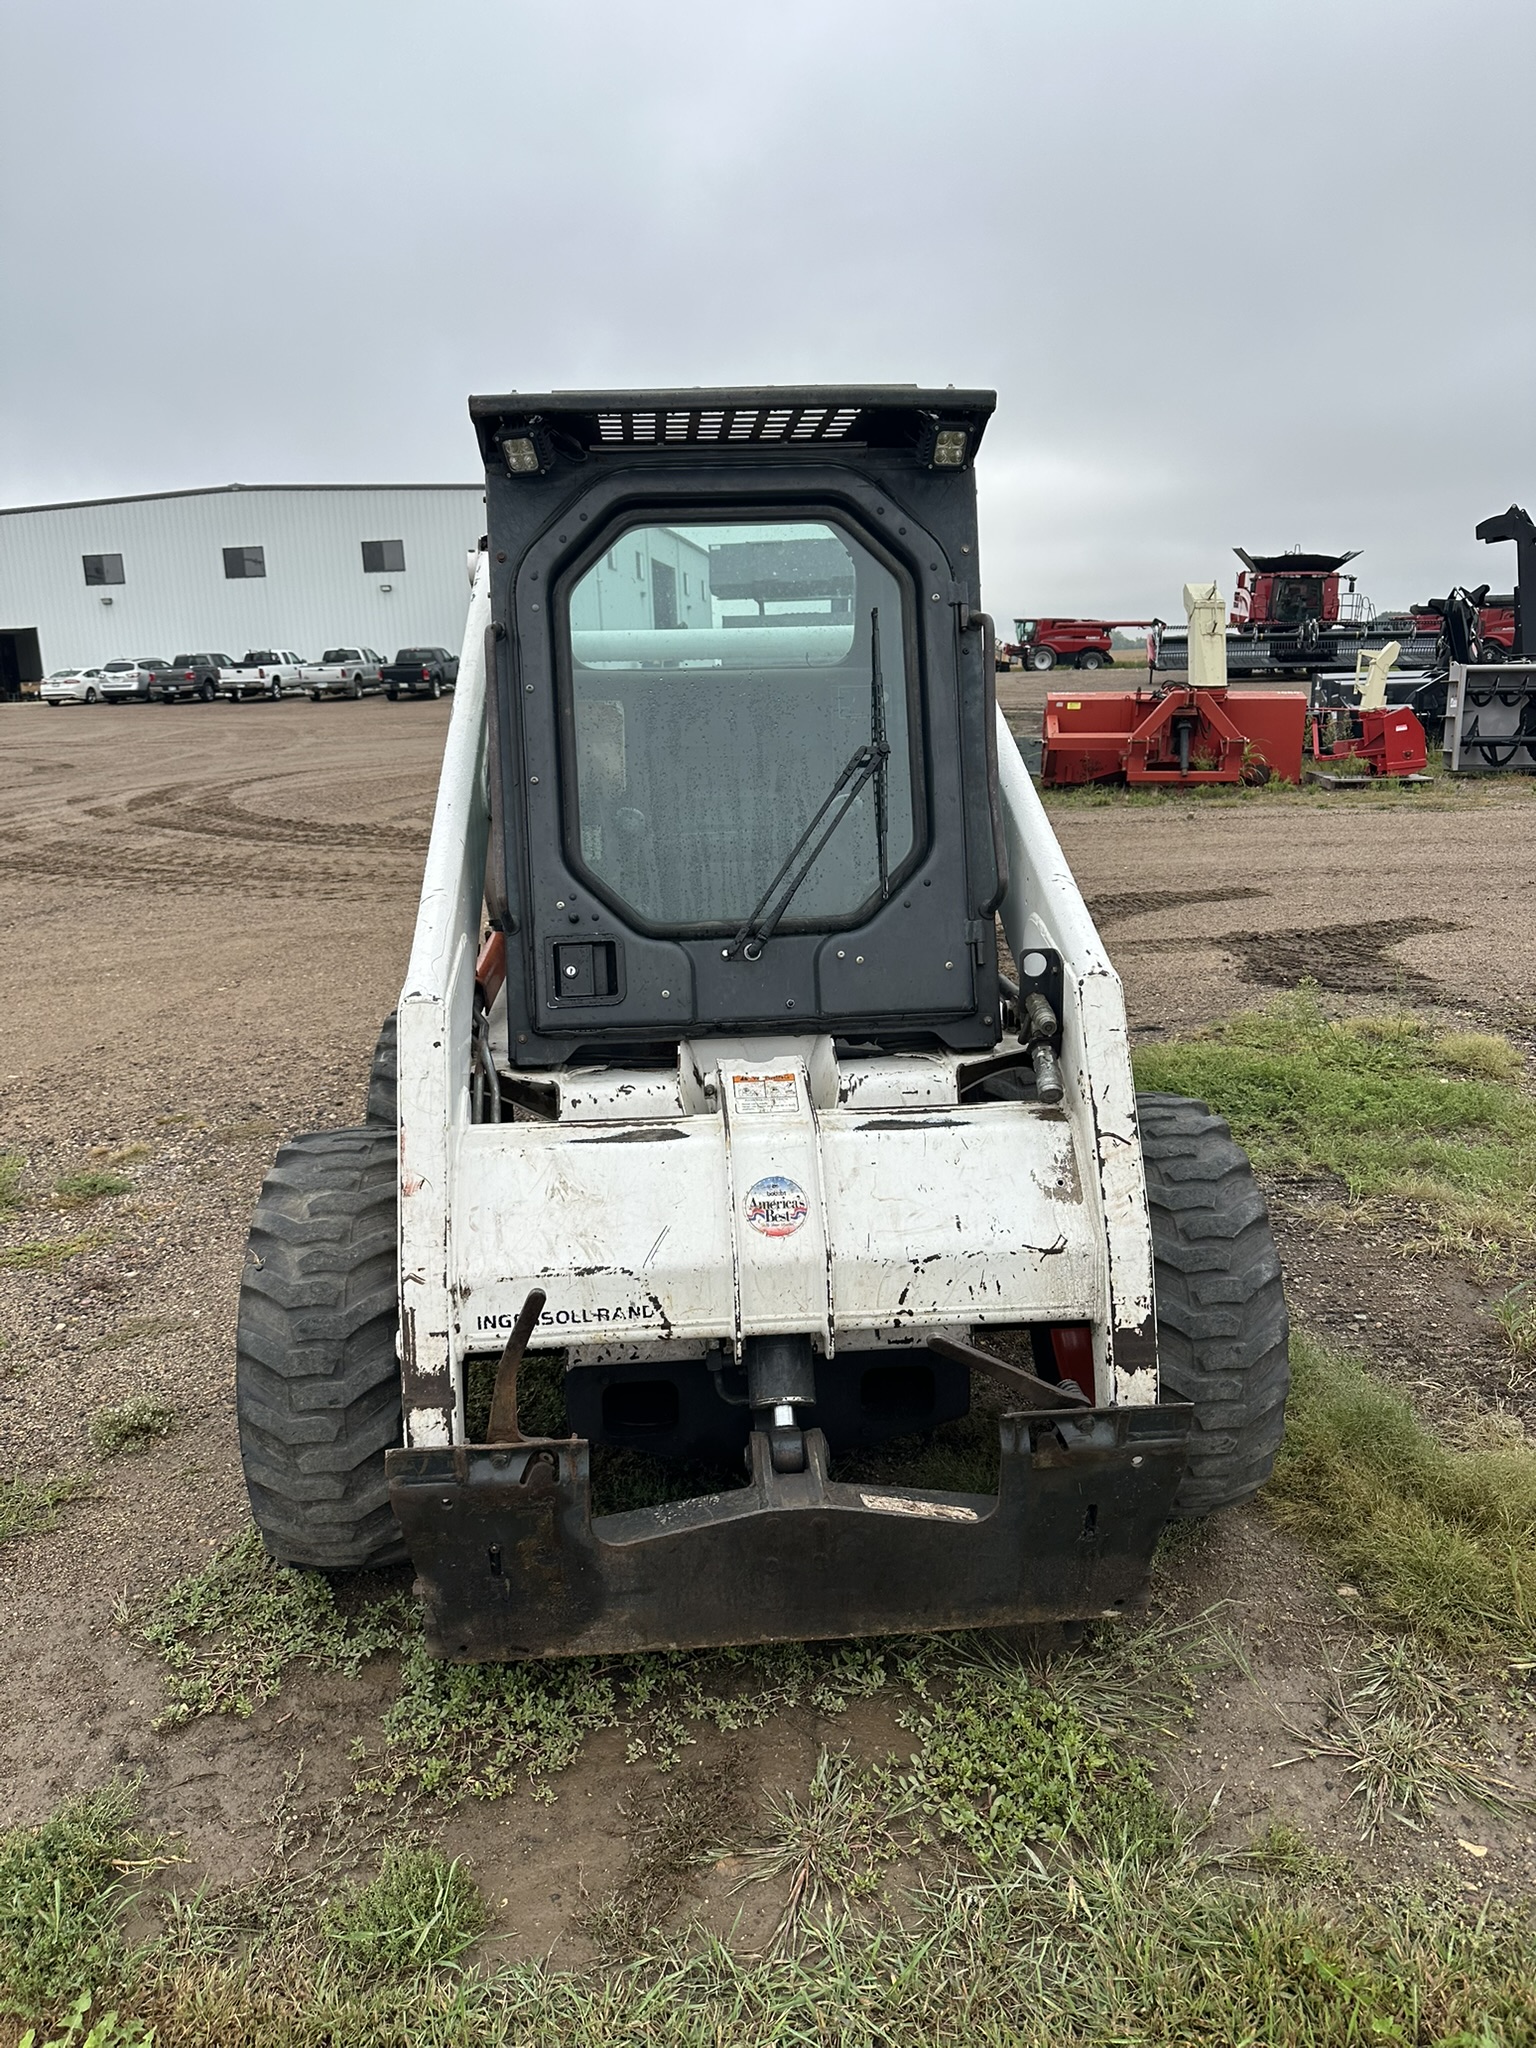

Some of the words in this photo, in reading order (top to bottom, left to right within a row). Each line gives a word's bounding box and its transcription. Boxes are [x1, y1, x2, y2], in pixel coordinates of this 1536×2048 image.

[749, 1194, 806, 1212] America's
[765, 1209, 790, 1222] Best
[477, 1305, 656, 1330] INGSOLL-RAND
